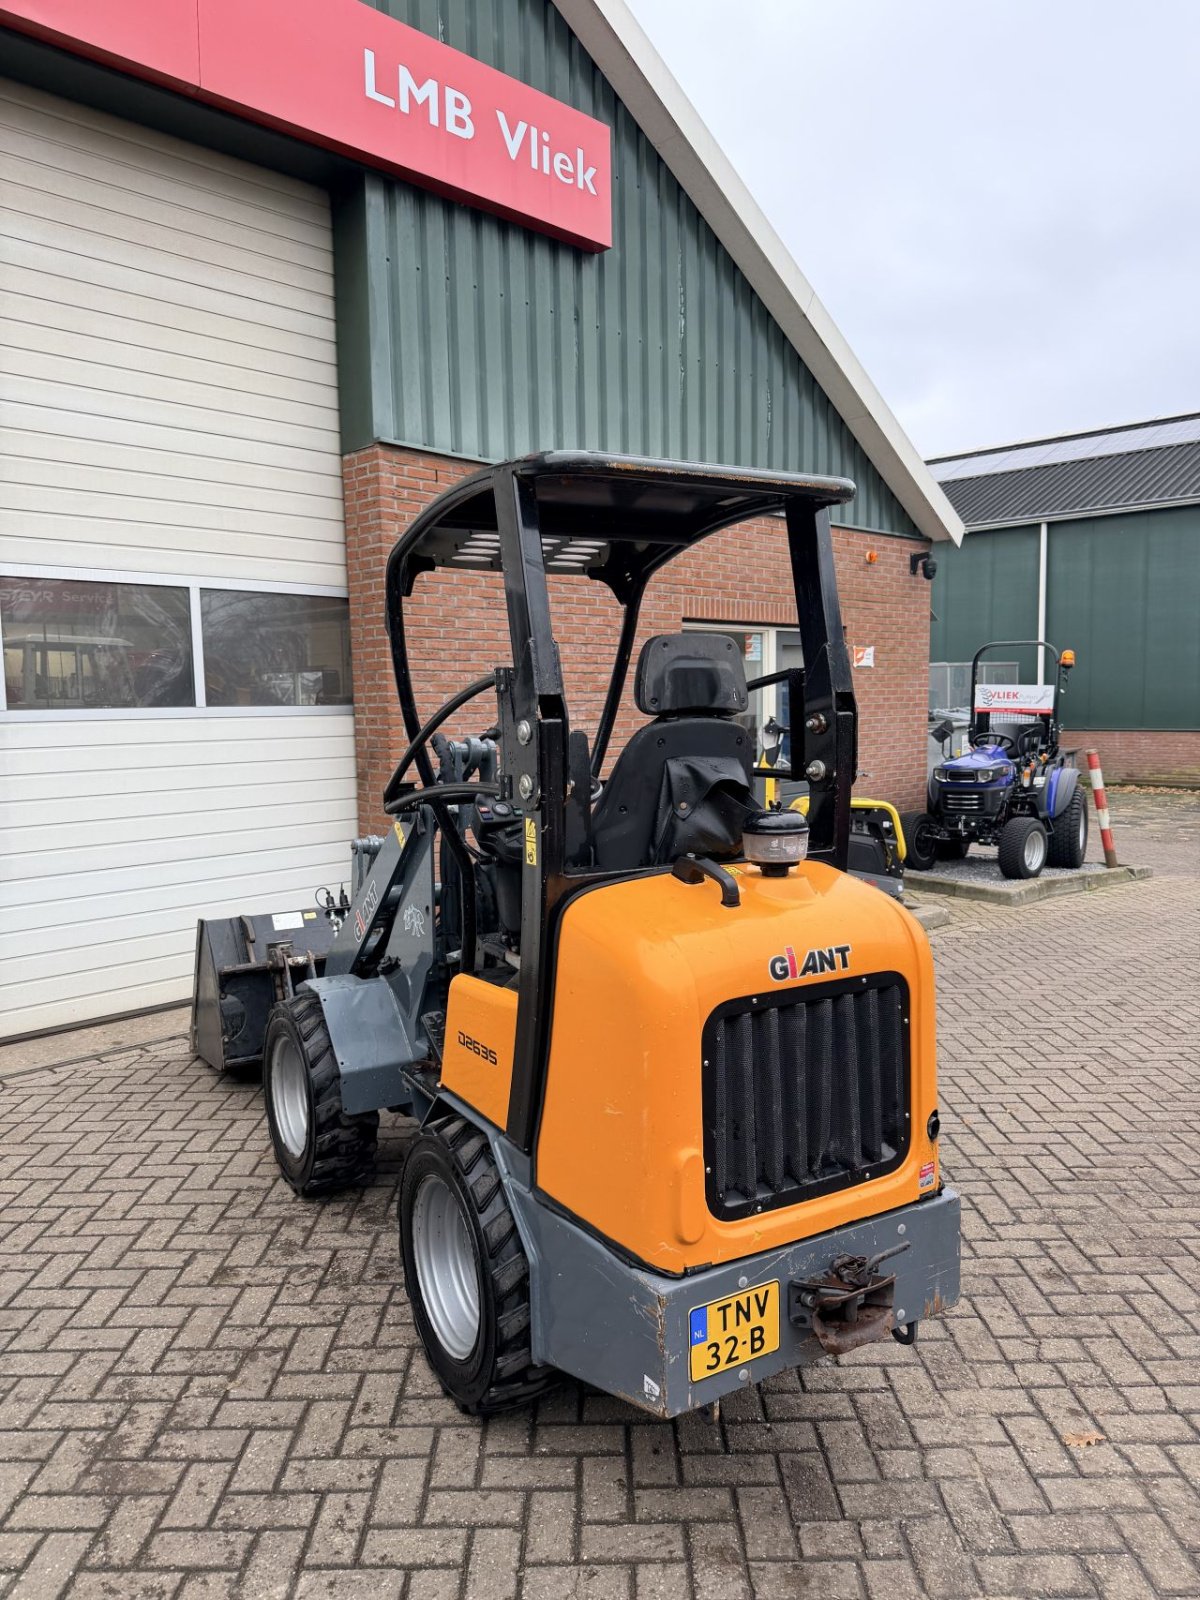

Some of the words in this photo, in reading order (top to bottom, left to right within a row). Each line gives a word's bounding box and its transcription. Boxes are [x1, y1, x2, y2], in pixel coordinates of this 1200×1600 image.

[364, 48, 475, 139] LMB
[496, 108, 598, 196] Vliek
[991, 690, 1020, 700] VLIEK
[717, 1289, 770, 1332] TNV
[694, 1329, 705, 1340] NL
[706, 1325, 766, 1371] 32-B
